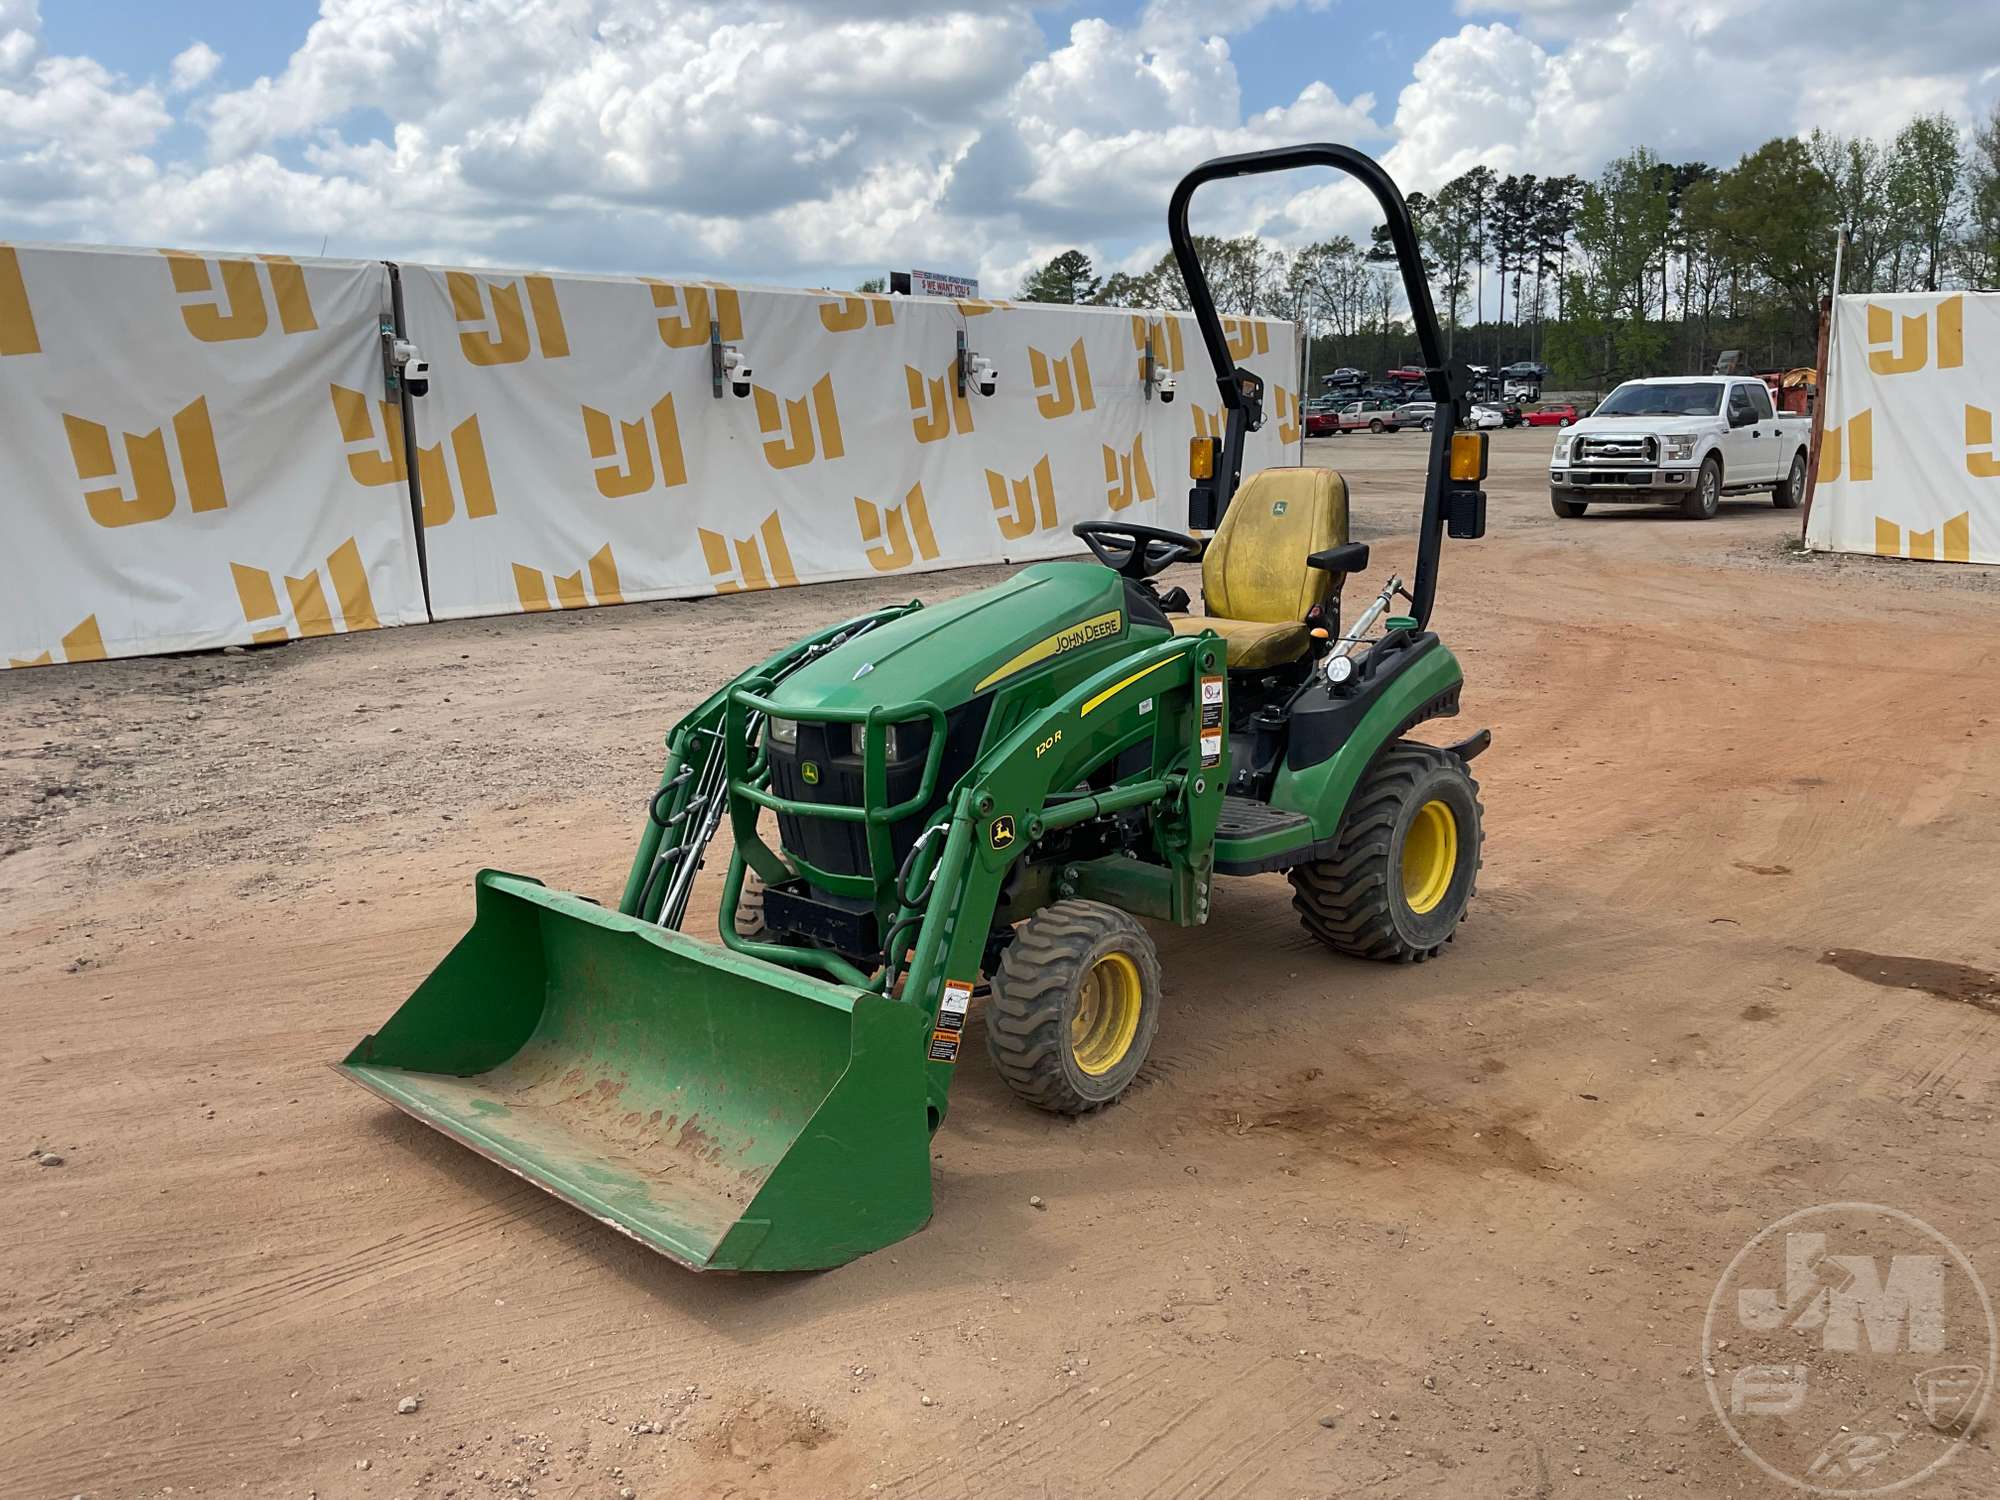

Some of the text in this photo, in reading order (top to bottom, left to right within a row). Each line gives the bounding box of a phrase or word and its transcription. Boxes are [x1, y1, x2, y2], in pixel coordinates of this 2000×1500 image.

[926, 280, 936, 290] WE
[936, 282, 953, 293] WANT
[1055, 619, 1118, 652] JOHN DEERE
